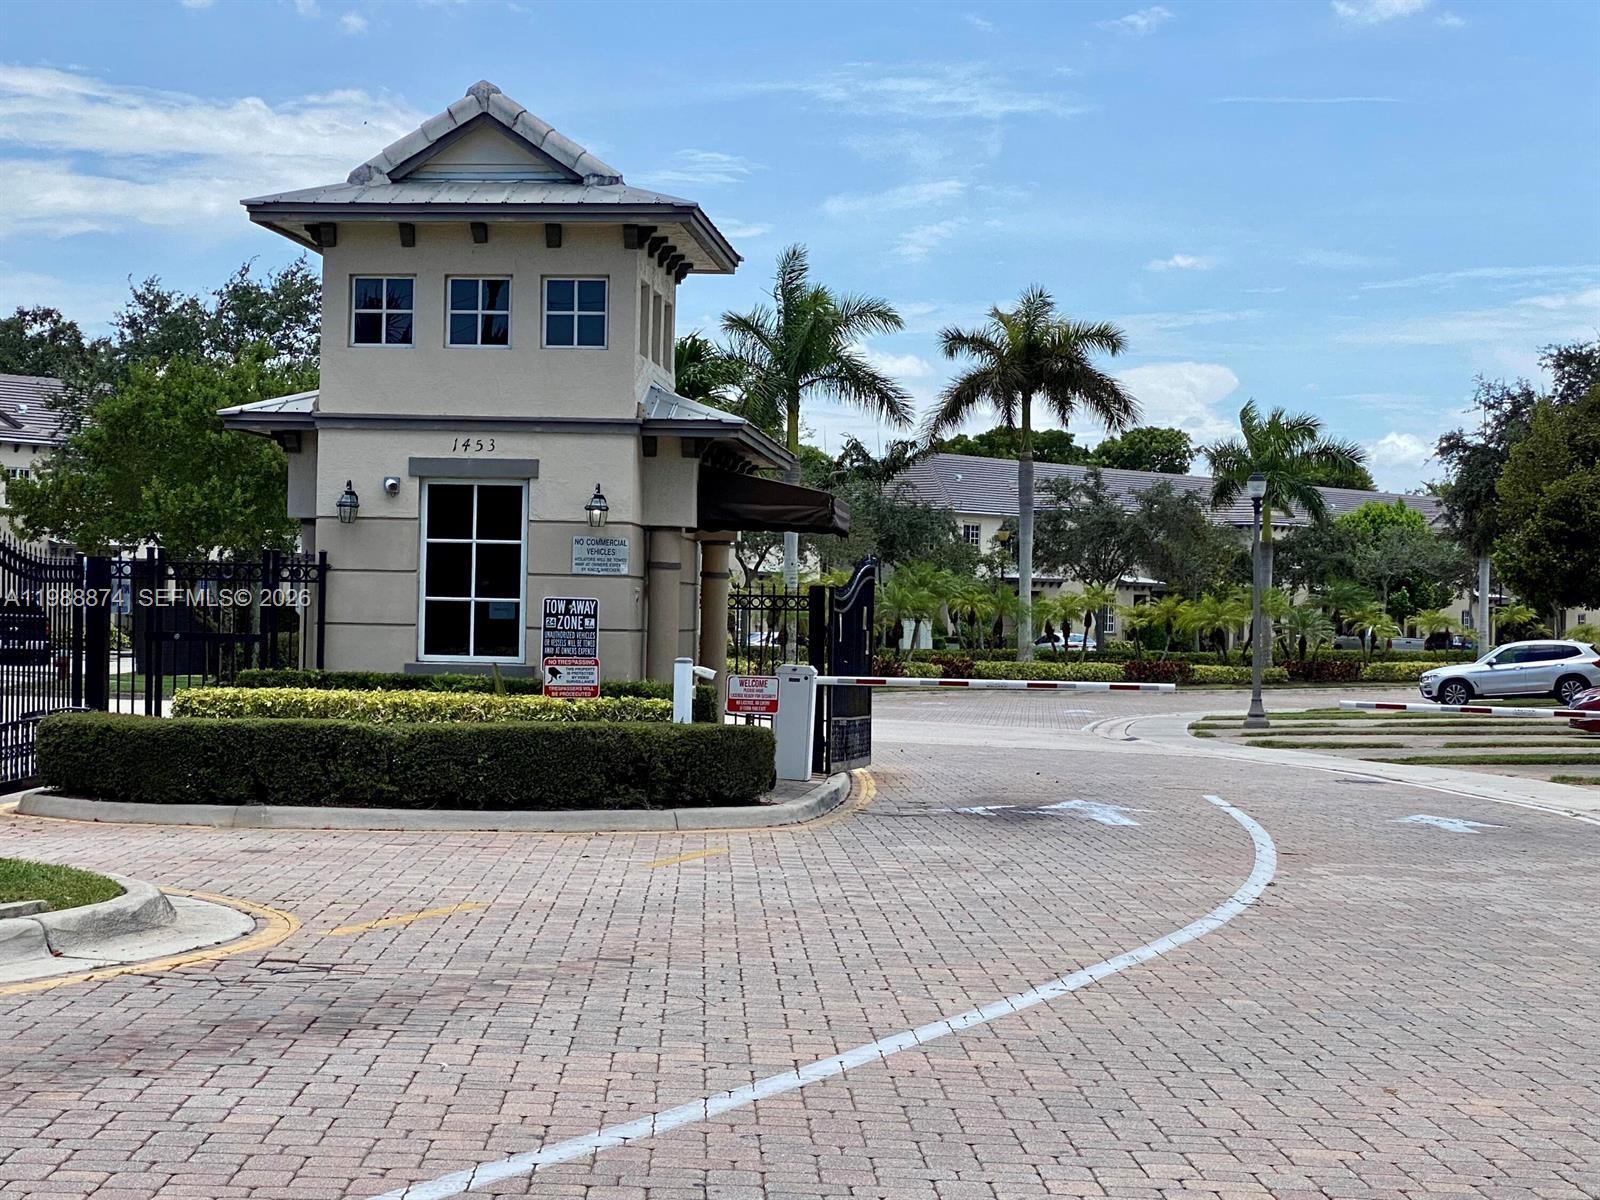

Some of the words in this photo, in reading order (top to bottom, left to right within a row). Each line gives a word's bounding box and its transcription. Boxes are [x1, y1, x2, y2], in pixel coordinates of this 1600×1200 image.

[452, 438, 496, 452] 1453
[574, 538, 584, 546] NO
[586, 538, 628, 547] COMMERCIAL
[586, 547, 616, 556] VEHICLES
[546, 599, 566, 614] TOW
[570, 600, 596, 615] AWAY
[557, 615, 584, 630] ZONE
[544, 631, 576, 639] UNAUTHORIZED
[576, 631, 596, 639] VEHICLES
[550, 639, 567, 647] VESSELS
[567, 639, 576, 647] WILL
[576, 639, 582, 647] BE
[582, 640, 596, 648] TOWED
[555, 647, 560, 655] AT
[577, 648, 596, 656] EXPENSE
[739, 679, 768, 688] WELCOME
